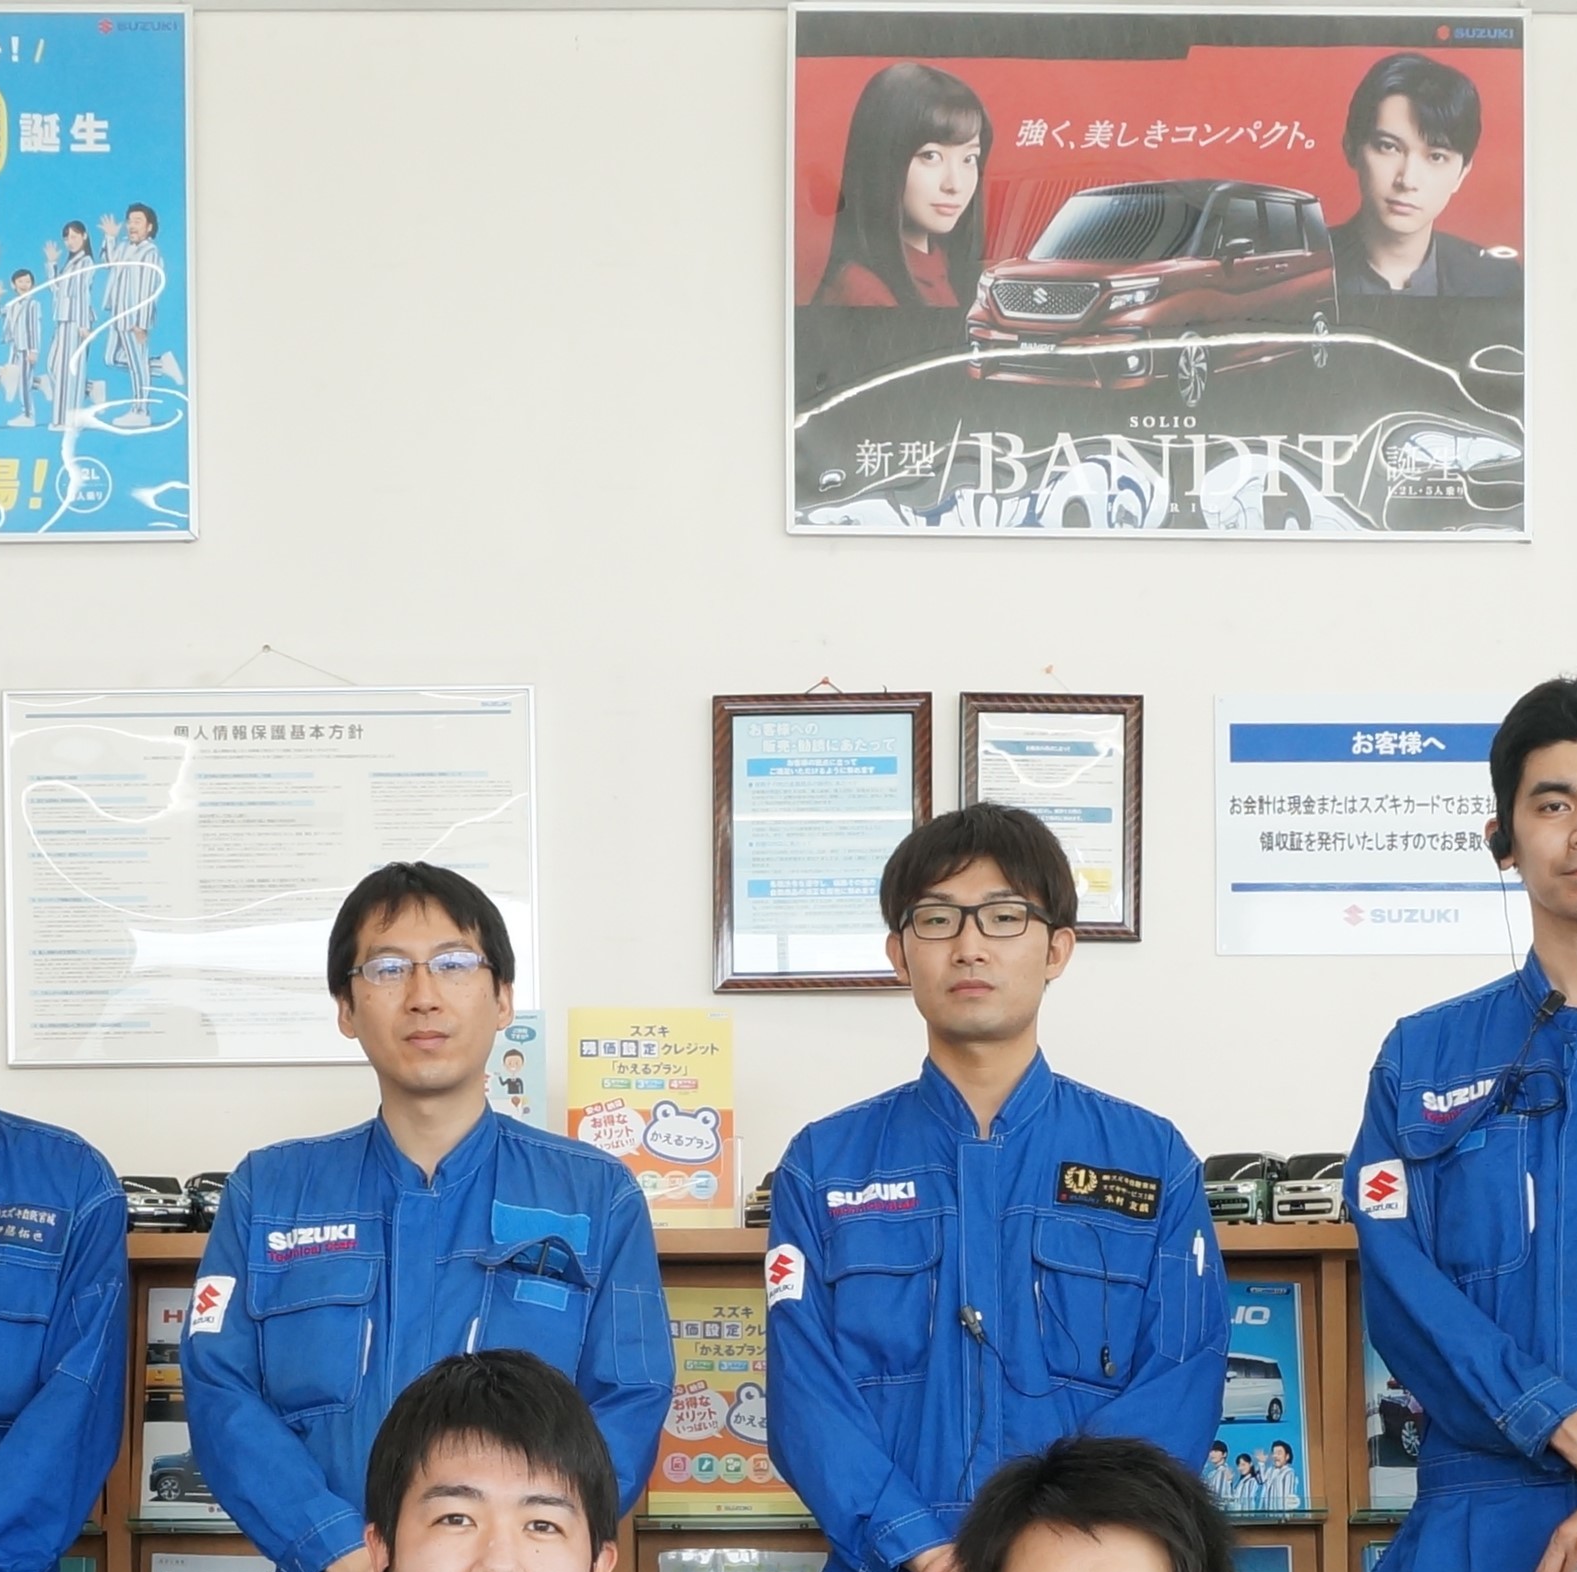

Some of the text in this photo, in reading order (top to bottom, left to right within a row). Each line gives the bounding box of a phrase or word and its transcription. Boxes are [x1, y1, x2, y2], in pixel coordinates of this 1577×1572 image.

[1454, 27, 1515, 40] SUZUKI
[19, 112, 112, 155] 誕生
[1016, 119, 1317, 150] 強く、美しきコンパクト。
[1130, 415, 1198, 429] SOLIO
[854, 440, 937, 479] 新型
[968, 431, 1358, 499] BANDIT
[173, 724, 365, 741] 個人情報保護基本方針
[748, 722, 818, 737] お客様への
[1351, 731, 1446, 755] お客様へ
[1370, 908, 1460, 924] SUZUKI
[630, 1025, 670, 1037] スズキ
[611, 1060, 688, 1076] 「かえるプラン」
[650, 1130, 715, 1151] かえるプラン
[1072, 1169, 1086, 1188] 1
[826, 1181, 916, 1208] SUZUKI
[268, 1223, 356, 1251] SUZUKI
[713, 1306, 754, 1319] スズキ
[675, 1409, 717, 1424] メリット
